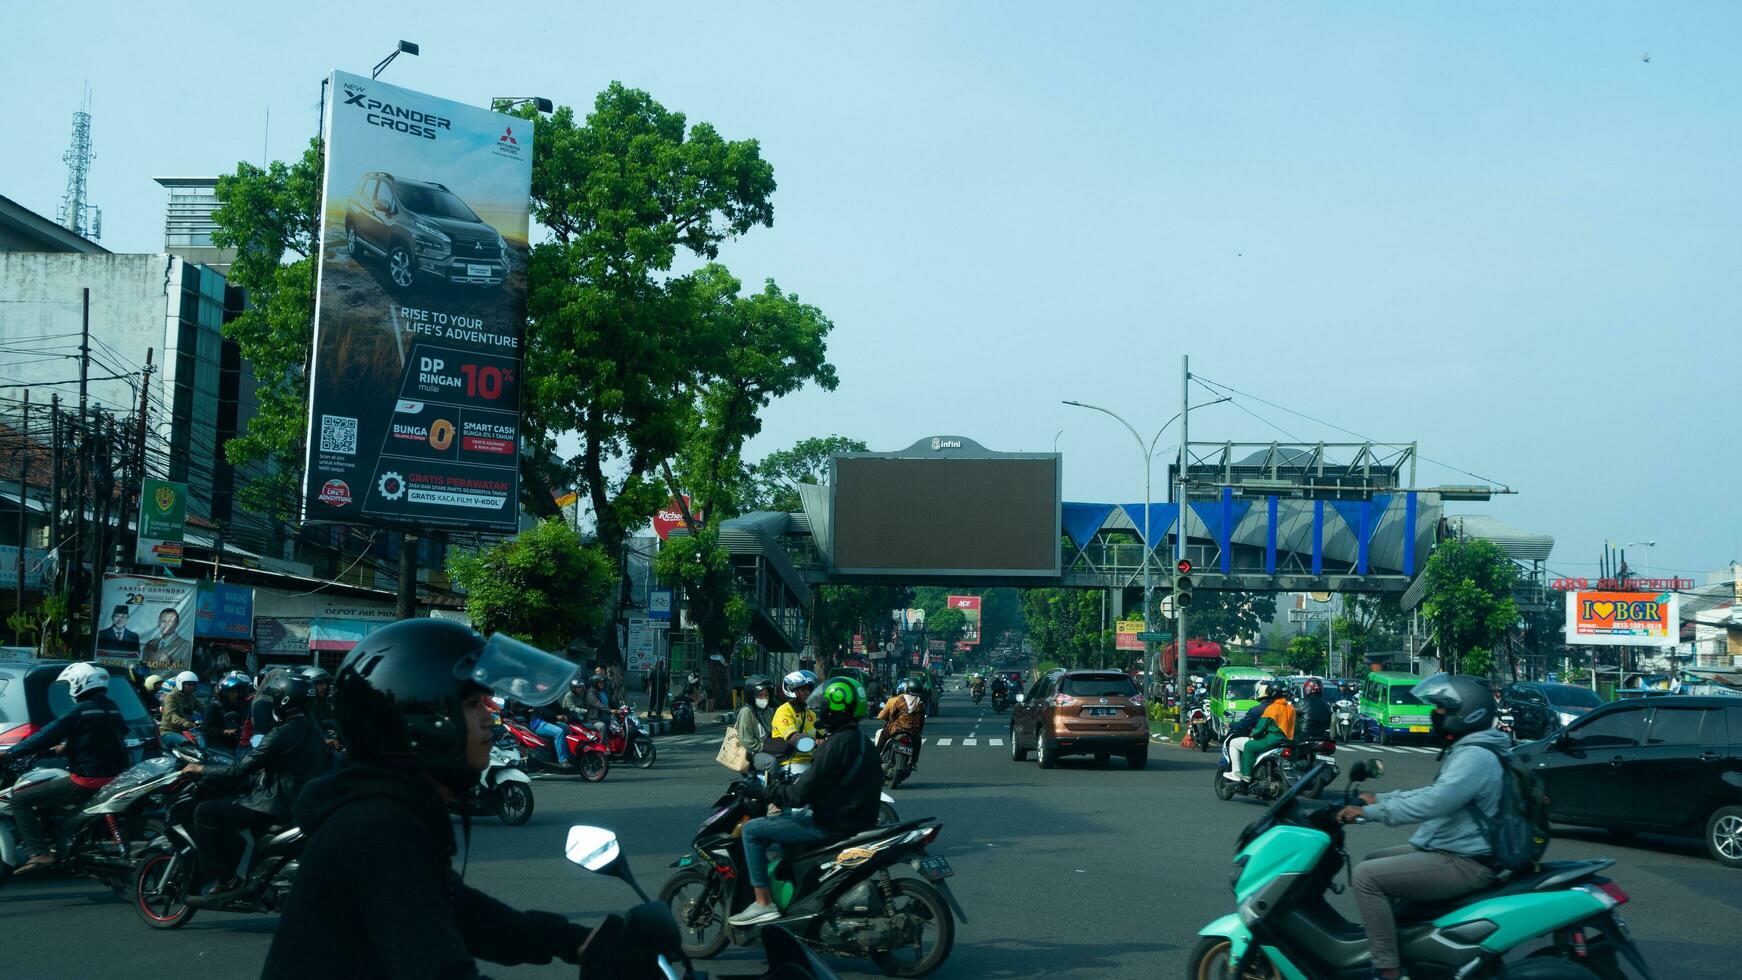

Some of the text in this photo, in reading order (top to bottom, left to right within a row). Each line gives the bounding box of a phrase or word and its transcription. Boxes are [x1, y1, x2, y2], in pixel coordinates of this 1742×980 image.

[343, 82, 366, 93] NEW
[343, 90, 452, 130] XPANDER
[366, 113, 436, 140] CROSS
[401, 307, 483, 330] RISE TO YOUR
[406, 322, 518, 348] LIFE'S ADVENTURE
[420, 357, 444, 373] DP
[419, 373, 462, 388] RINGAN
[418, 384, 440, 393] mulai
[393, 424, 428, 436] BUNGA
[463, 421, 515, 435] SMART CASH
[463, 430, 482, 438] BUNGA
[408, 473, 510, 490] GRATIS PERAWATAN
[119, 585, 145, 593] PARTAI
[1552, 577, 1588, 591] 489
[957, 599, 971, 607] ACE
[325, 608, 355, 616] DEPOT
[358, 609, 376, 617] AIR
[1583, 600, 1661, 621] I BGR
